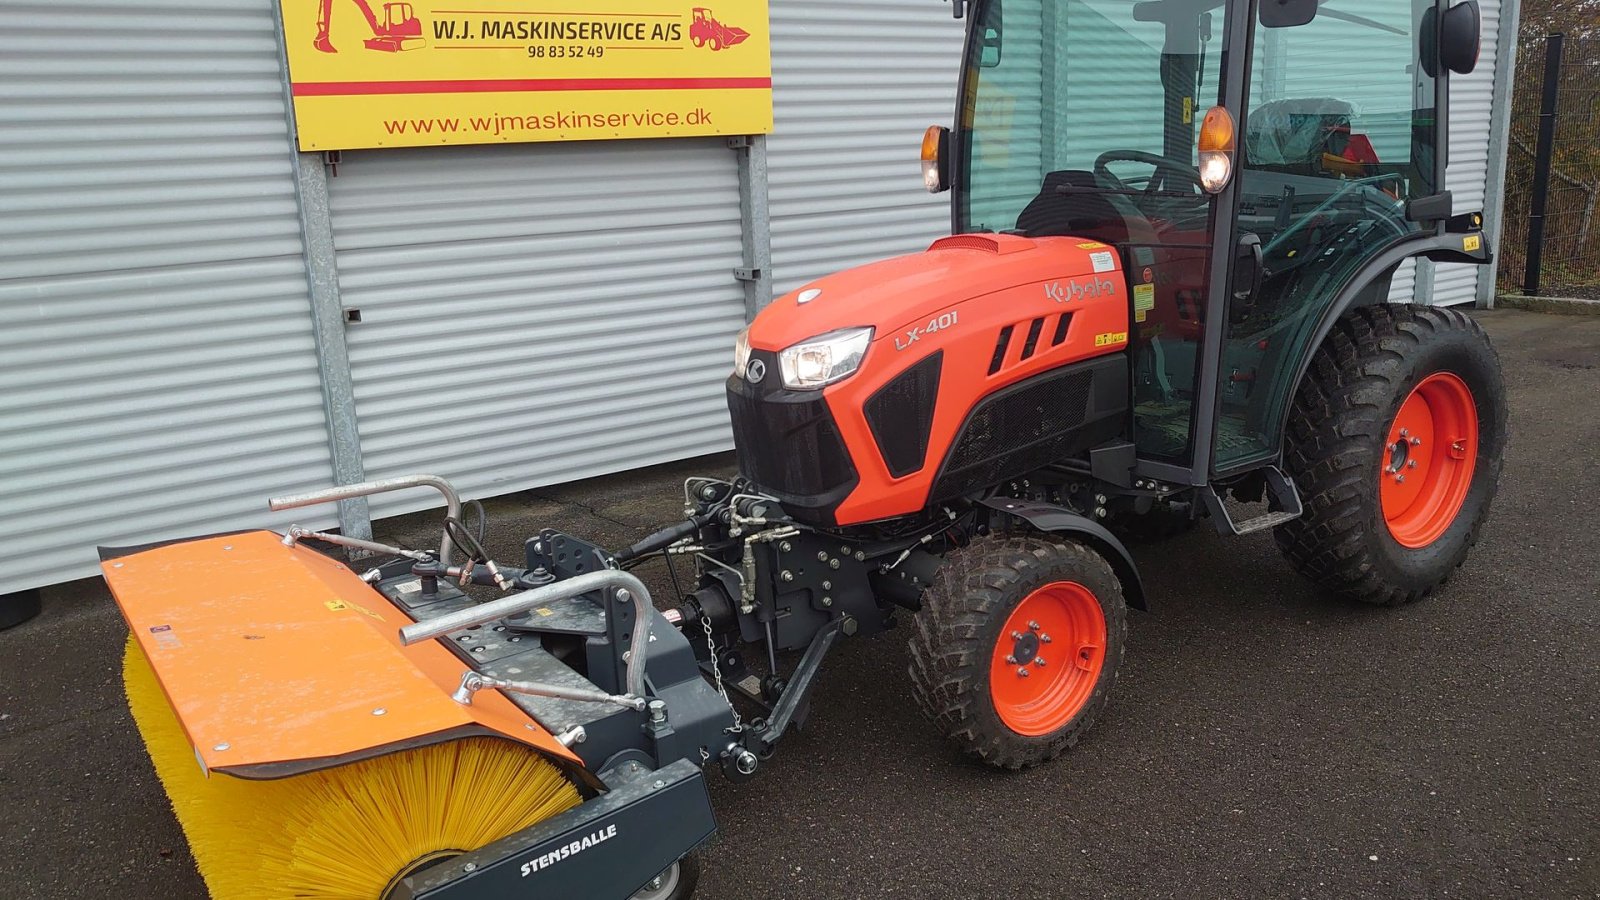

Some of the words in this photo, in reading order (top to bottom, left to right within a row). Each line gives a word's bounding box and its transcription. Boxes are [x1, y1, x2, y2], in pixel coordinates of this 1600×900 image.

[433, 20, 475, 40] W.J.
[481, 21, 646, 41] MASKINSERVICE
[651, 23, 682, 42] A/S
[528, 46, 545, 58] 98
[548, 46, 565, 58] 83
[568, 46, 584, 58] 52
[587, 46, 604, 58] 49
[384, 108, 712, 135] www.wjmaskinservice.dk
[1044, 277, 1115, 302] Kubota
[895, 310, 958, 351] LX-401
[520, 824, 617, 878] STENSBALLE
